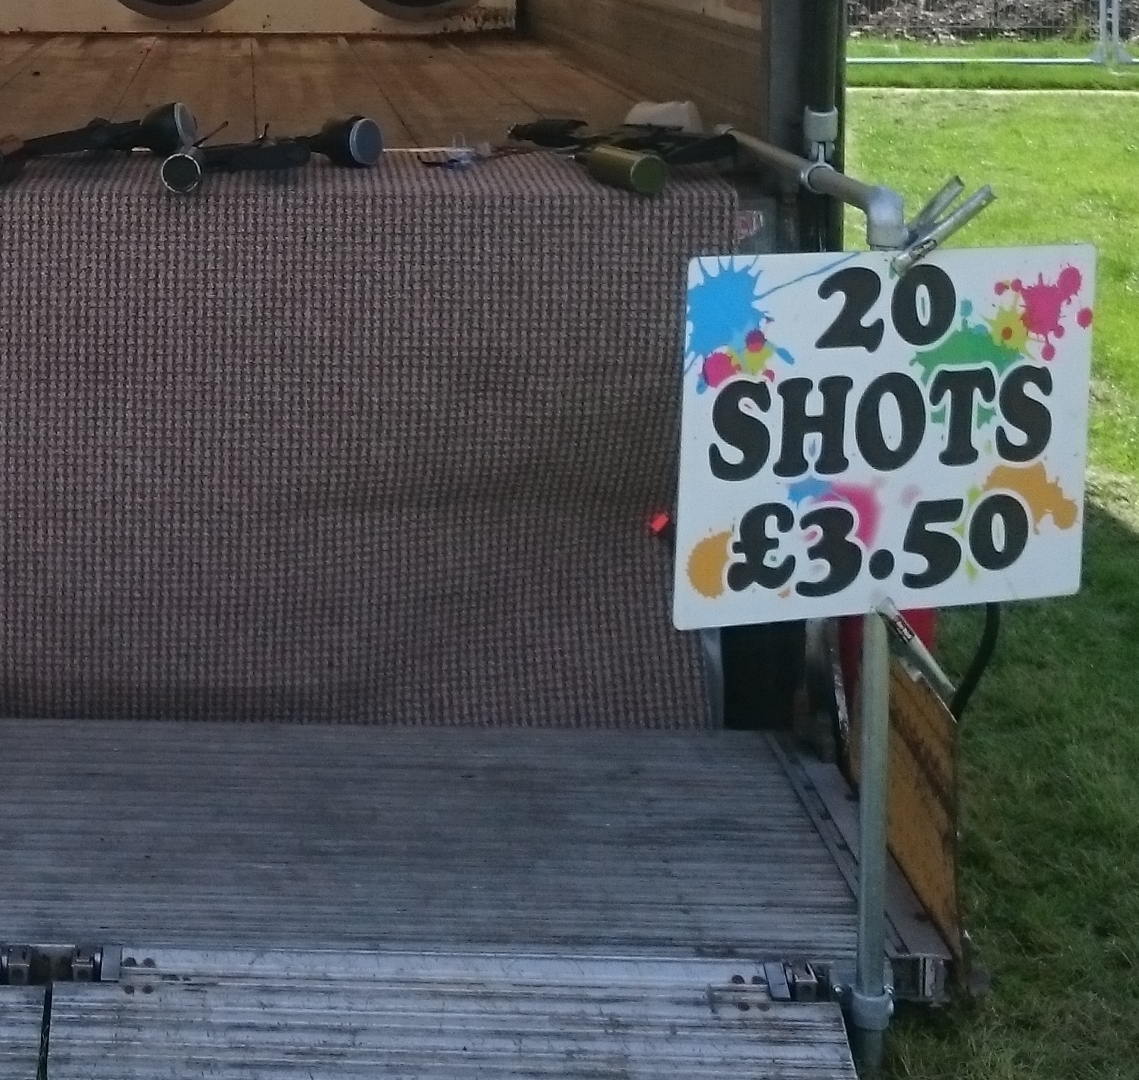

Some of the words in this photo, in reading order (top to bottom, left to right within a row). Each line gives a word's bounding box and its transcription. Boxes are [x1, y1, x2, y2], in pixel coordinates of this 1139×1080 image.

[816, 264, 957, 353] 20
[708, 365, 1053, 482] SHOTS
[727, 493, 1030, 597] £3.50
